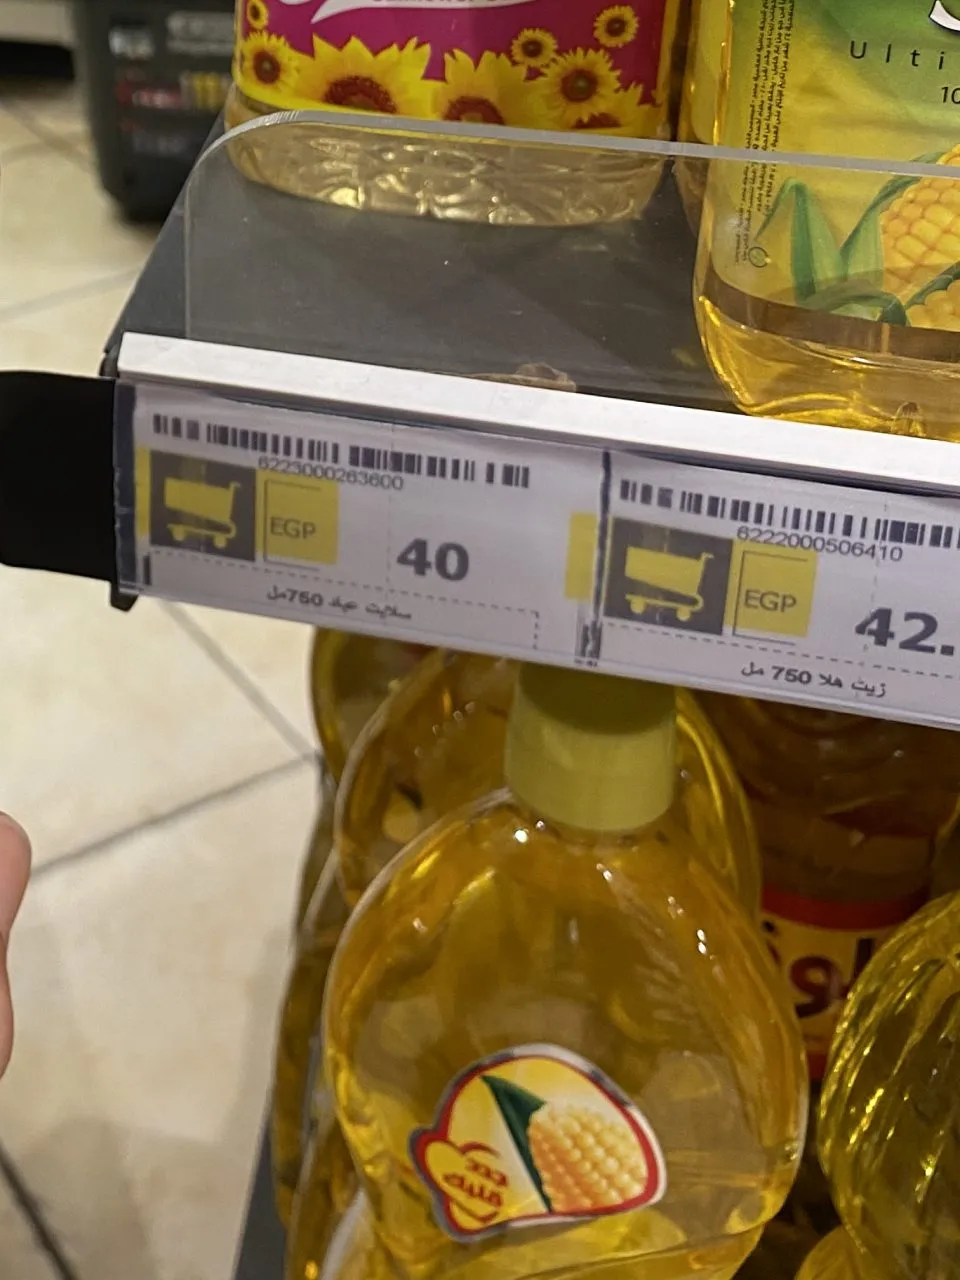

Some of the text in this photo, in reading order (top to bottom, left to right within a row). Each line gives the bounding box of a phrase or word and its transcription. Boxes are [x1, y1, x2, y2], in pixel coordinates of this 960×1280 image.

[269, 517, 316, 539] EGP
[736, 525, 903, 562] 6222000506410
[396, 538, 469, 582] 40
[743, 589, 796, 612] EGP
[741, 662, 886, 698] زيت هلا 750 مل
